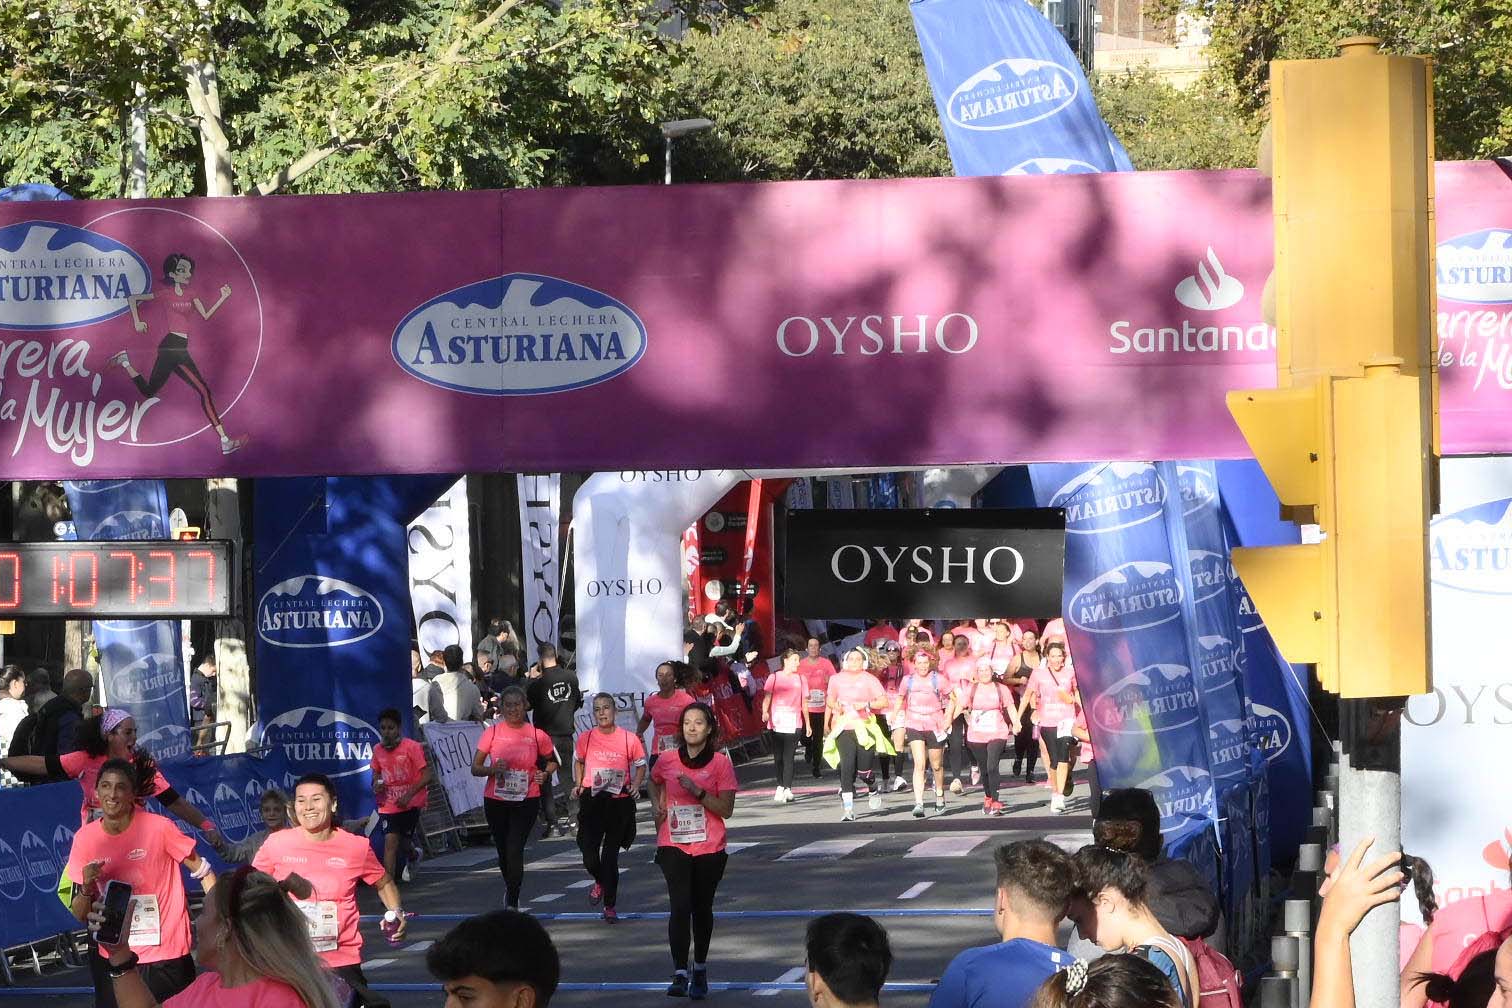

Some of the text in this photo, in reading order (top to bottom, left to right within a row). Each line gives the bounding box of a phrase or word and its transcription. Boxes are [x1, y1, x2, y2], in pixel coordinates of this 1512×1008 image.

[54, 257, 126, 269] LECHERA
[451, 313, 618, 329] CENTRAL LECHERA
[411, 321, 627, 365] ASTURIANA
[776, 312, 979, 358] OYSHO
[12, 367, 161, 467] Mujer
[831, 545, 1025, 585] OYSHO
[587, 578, 663, 597] OYSHO
[273, 598, 370, 609] CENTRAL LECHERA
[261, 605, 375, 632] ASTURIANA
